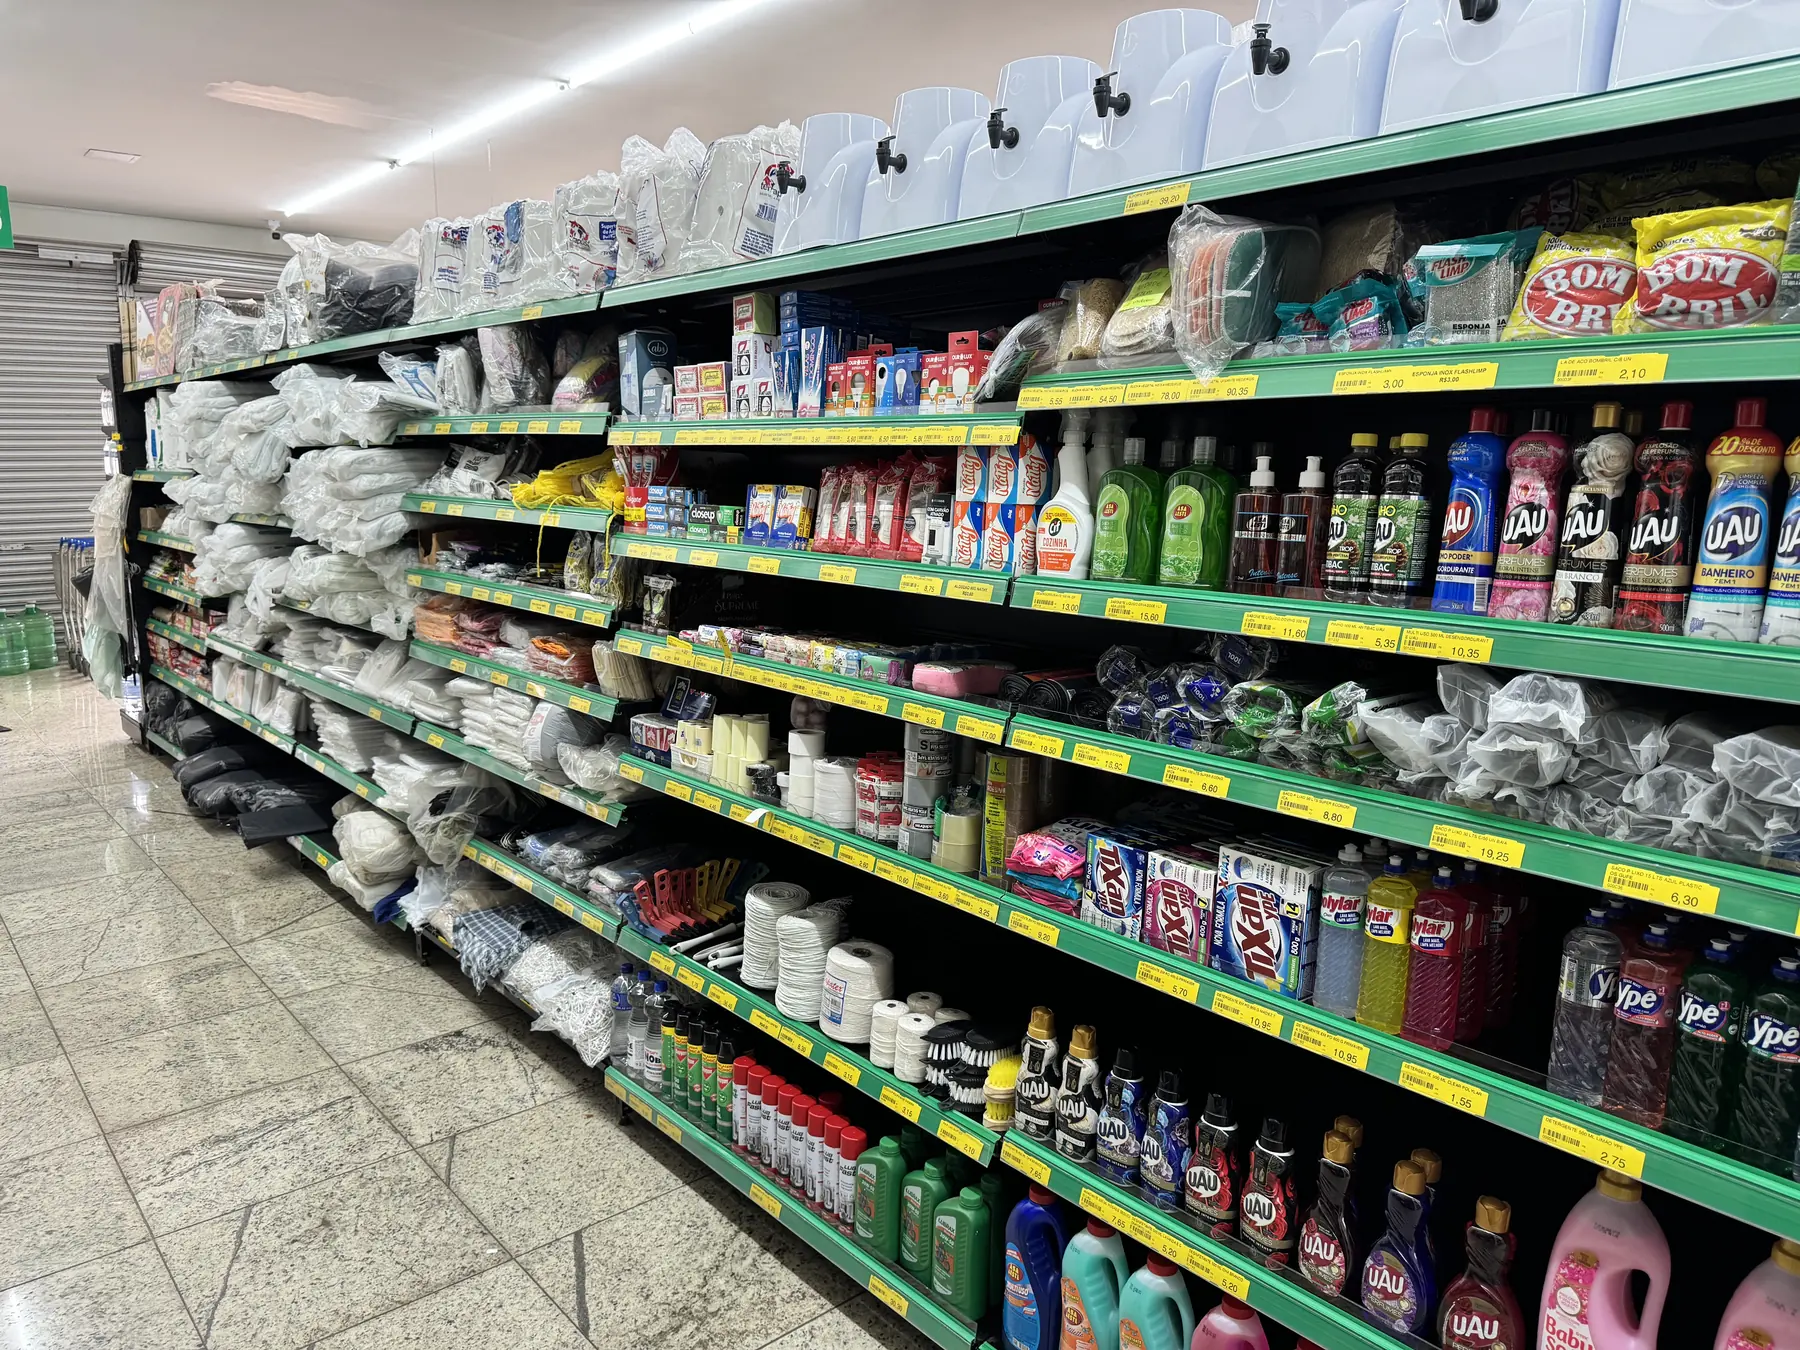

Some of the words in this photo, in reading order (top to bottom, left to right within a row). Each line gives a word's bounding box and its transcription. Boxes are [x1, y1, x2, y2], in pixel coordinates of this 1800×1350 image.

[1432, 256, 1468, 272] FLASH
[1440, 261, 1471, 280] LIMP
[1540, 264, 1637, 296] BOM
[1642, 254, 1748, 294] BOM
[1343, 302, 1374, 325] LIMP
[1651, 287, 1768, 326] BRIL
[1546, 301, 1624, 330] BRI
[1452, 323, 1491, 331] ESPONJA
[1452, 367, 1487, 375] FLASHLIMP
[1619, 368, 1647, 380] 2,10
[1383, 378, 1404, 389] 3,00
[1160, 391, 1181, 400] 78,00
[1226, 387, 1249, 397] 90,35
[1099, 395, 1118, 404] 54,50
[947, 435, 962, 443] 13,00
[1711, 436, 1741, 455] 20
[1738, 444, 1776, 454] DESCONTO
[691, 508, 716, 523] closeup
[1442, 506, 1472, 537] AU
[689, 526, 708, 536] closeup
[1502, 508, 1546, 543] UAU
[1562, 509, 1605, 542] UAU
[1705, 513, 1761, 551] UAU
[1630, 515, 1679, 551] UAU
[1042, 537, 1068, 548] COZINHA
[1437, 566, 1475, 575] GORDURANTE
[1558, 561, 1608, 571] ERFUMES
[1623, 567, 1679, 578] PERFUMES
[1701, 567, 1755, 579] BANHEIRO
[1565, 572, 1600, 582] BRANCO
[1772, 570, 1800, 583] BANHE
[923, 585, 935, 593] 8,75
[1062, 603, 1079, 612] 13,00
[1139, 611, 1160, 622] 15,60
[1283, 627, 1307, 638] 11,60
[1659, 622, 1676, 633] 500ml
[1374, 637, 1397, 649] 5,35
[1452, 646, 1480, 659] 10,35
[926, 717, 937, 726] 5,25
[981, 730, 997, 741] 17,00
[1039, 744, 1057, 755] 19,50
[1201, 782, 1219, 793] 6,60
[1322, 811, 1343, 823] 8,80
[1480, 847, 1510, 862] 19,25
[1611, 865, 1626, 873] SACO
[1631, 869, 1645, 878] LIXO
[1652, 874, 1663, 882] LTS
[1664, 876, 1678, 885] AZUL
[1679, 879, 1704, 890] PLASTIC
[937, 891, 949, 901] 3,60
[1670, 892, 1699, 907] 6,30
[978, 907, 990, 917] 3,25
[1285, 902, 1300, 917] 14
[1037, 931, 1050, 941] 9,20
[1213, 931, 1224, 948] NOVA
[1290, 942, 1300, 956] 800
[1172, 985, 1188, 997] 5,70
[1615, 981, 1656, 1011] Ypê
[1678, 995, 1720, 1026] Ypê
[1250, 1016, 1272, 1031] 10,95
[1747, 1017, 1800, 1049] Ypê
[1333, 1048, 1358, 1064] 10,95
[1404, 1063, 1432, 1077] DETERGENTE
[1447, 1078, 1462, 1089] CLEAR
[1461, 1084, 1483, 1097] POLYLAR
[1021, 1080, 1049, 1099] UAU
[901, 1106, 913, 1118] 3,15
[1058, 1098, 1086, 1119] UAU
[1099, 1119, 1128, 1141] UAU
[1545, 1117, 1578, 1134] DETERGENTE
[1612, 1142, 1624, 1151] YPE
[963, 1143, 976, 1155] 2,10
[1600, 1151, 1626, 1169] 2,75
[1029, 1167, 1042, 1180] 7,65
[1188, 1169, 1218, 1191] UAU
[1245, 1196, 1273, 1220] UAU
[937, 1217, 955, 1233] LUBRAX
[1111, 1215, 1126, 1229] 7,65
[1161, 1244, 1178, 1258] 5,20
[1304, 1234, 1335, 1261] UAU
[1221, 1278, 1238, 1293] 5,20
[1368, 1267, 1405, 1295] UAU
[1367, 1293, 1405, 1318] PERFUMES
[1453, 1314, 1499, 1340] UAU
[1546, 1314, 1594, 1350] Baby
